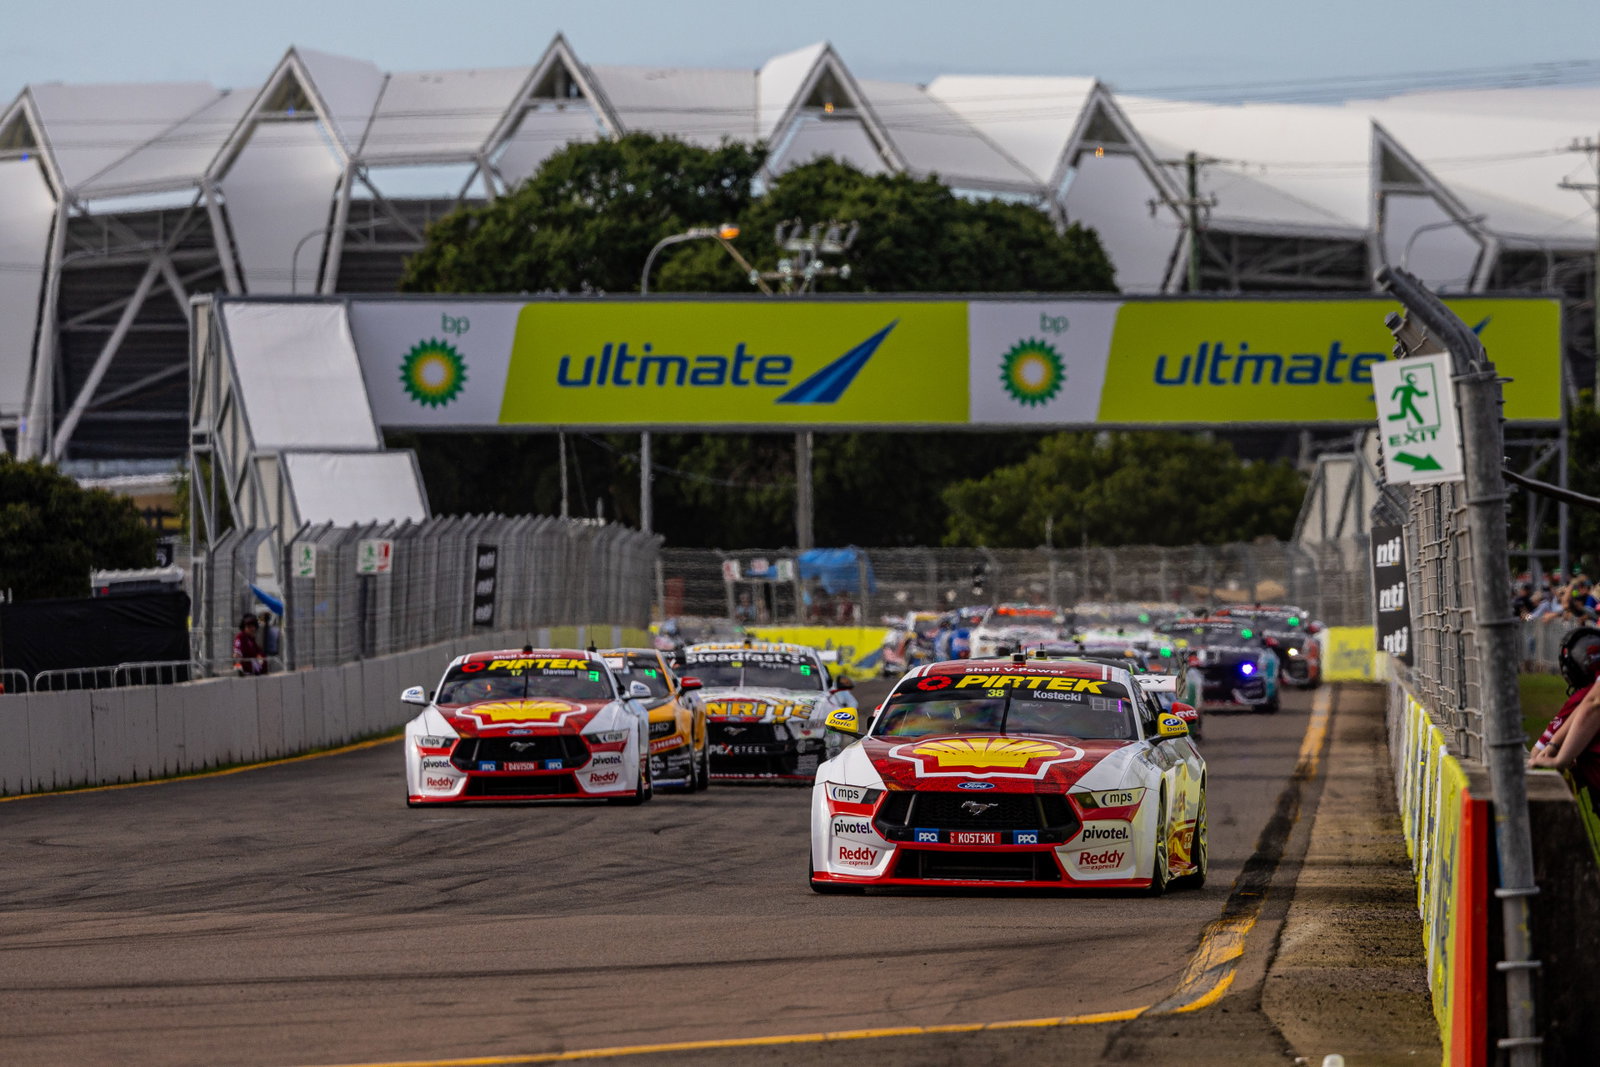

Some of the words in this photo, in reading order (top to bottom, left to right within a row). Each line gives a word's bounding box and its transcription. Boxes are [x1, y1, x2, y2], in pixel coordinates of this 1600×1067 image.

[441, 313, 470, 338] bp
[1040, 312, 1068, 337] bp
[556, 341, 794, 387] ultimate
[1154, 340, 1387, 386] ultimate
[1388, 430, 1438, 447] EXIT
[1376, 537, 1401, 563] nti
[1379, 582, 1404, 608] nti
[1383, 627, 1408, 655] nti
[686, 653, 784, 664] Steadfast
[487, 659, 589, 671] PIRTEK
[800, 665, 811, 676] 5
[511, 669, 523, 677] 17
[543, 668, 576, 676] Davison
[644, 669, 657, 679] 4
[955, 675, 1109, 695] PIRTEK
[987, 689, 1005, 698] 38
[1033, 690, 1082, 702] Kostecki
[829, 719, 852, 727] Doric
[427, 777, 454, 789] Reddy
[590, 771, 619, 783] Reddy
[838, 788, 860, 801] mps
[1109, 792, 1133, 805] mps
[918, 832, 938, 842] PPQ
[1017, 834, 1038, 844] PPQ
[839, 846, 878, 866] Reddy
[1079, 849, 1125, 868] Reddy
[1090, 863, 1116, 871] express
